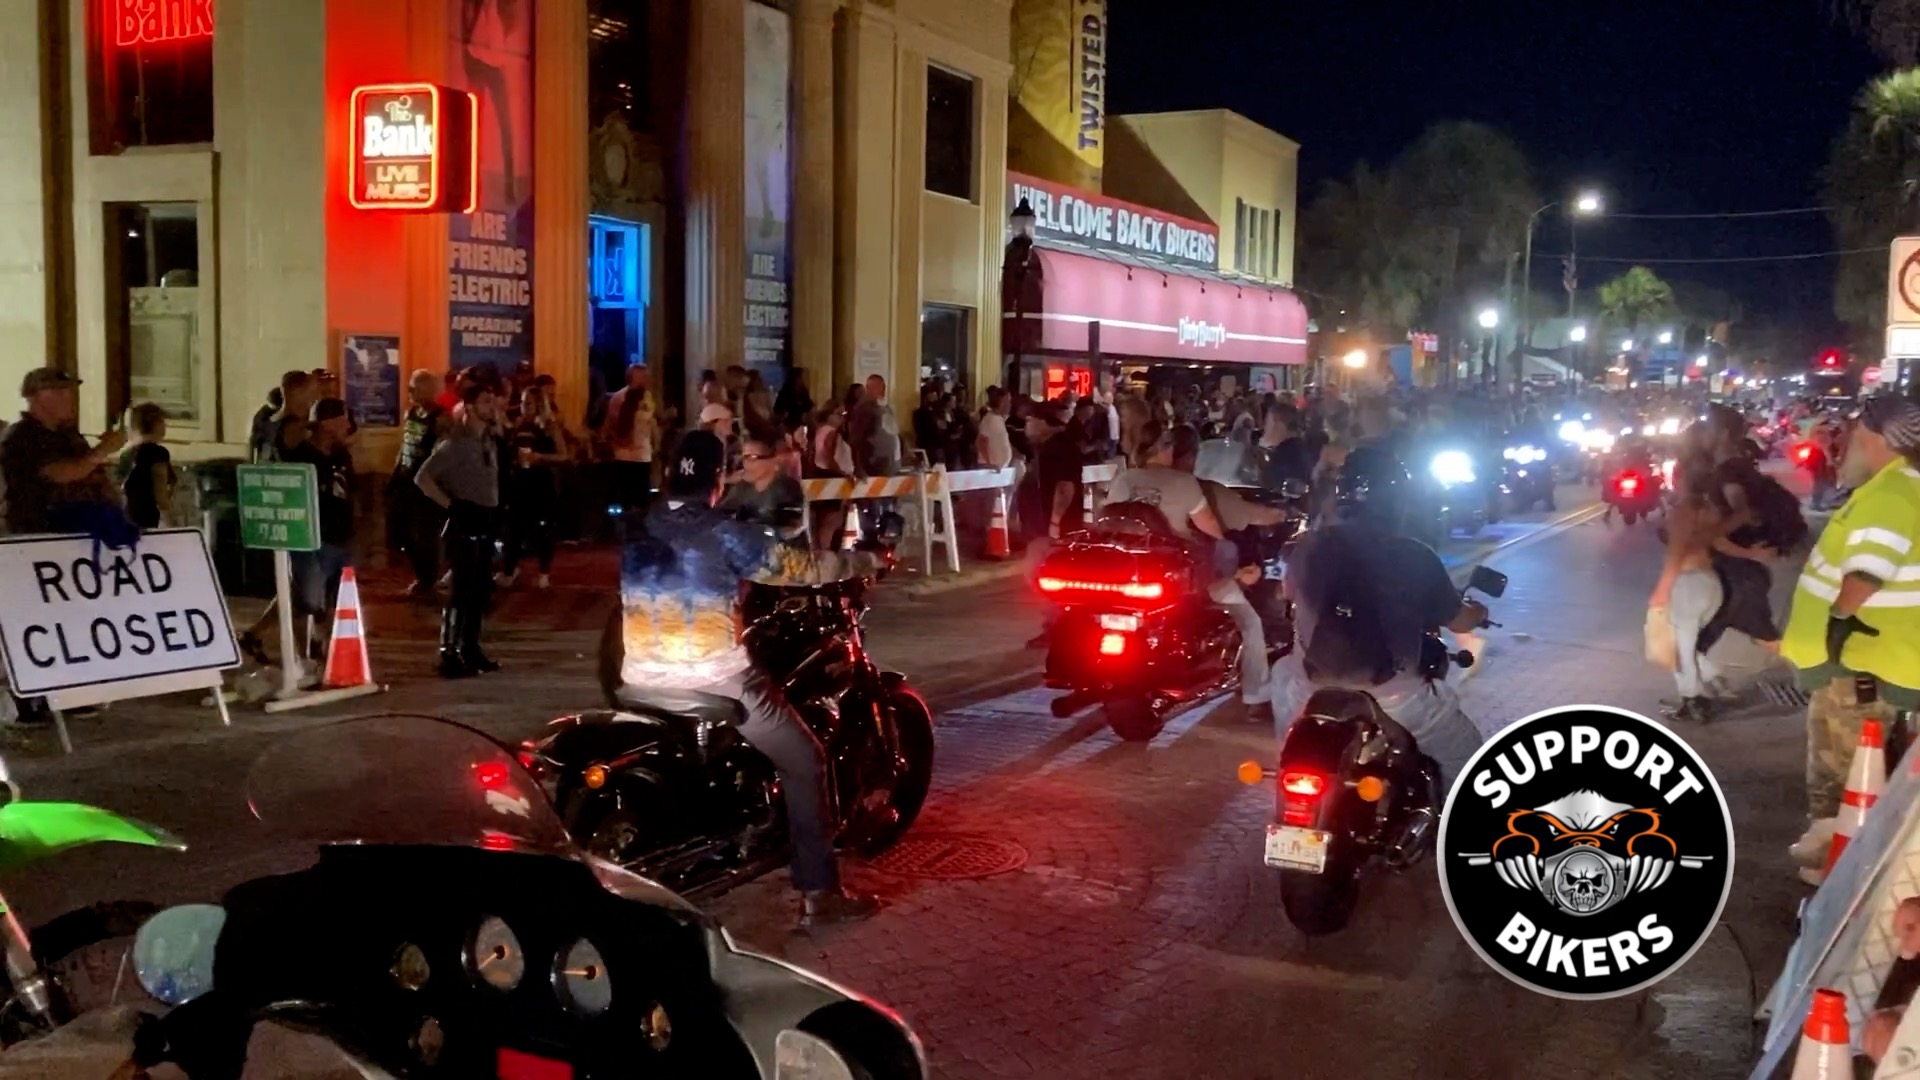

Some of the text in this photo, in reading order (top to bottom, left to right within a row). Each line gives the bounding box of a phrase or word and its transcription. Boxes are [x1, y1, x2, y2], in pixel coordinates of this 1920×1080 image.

[116, 0, 213, 46] Bank
[1078, 14, 1102, 150] TWISTED
[384, 95, 412, 122] The
[363, 114, 433, 157] Bank
[365, 183, 430, 200] MUSIC
[376, 165, 419, 182] LIVE
[470, 211, 507, 241] ARE
[1014, 183, 1216, 264] WELCOME BACK BIKERS
[448, 241, 528, 275] FRIENDS
[449, 273, 531, 306] ELECTRIC
[33, 553, 173, 603] ROAD
[23, 608, 215, 668] CLOSED
